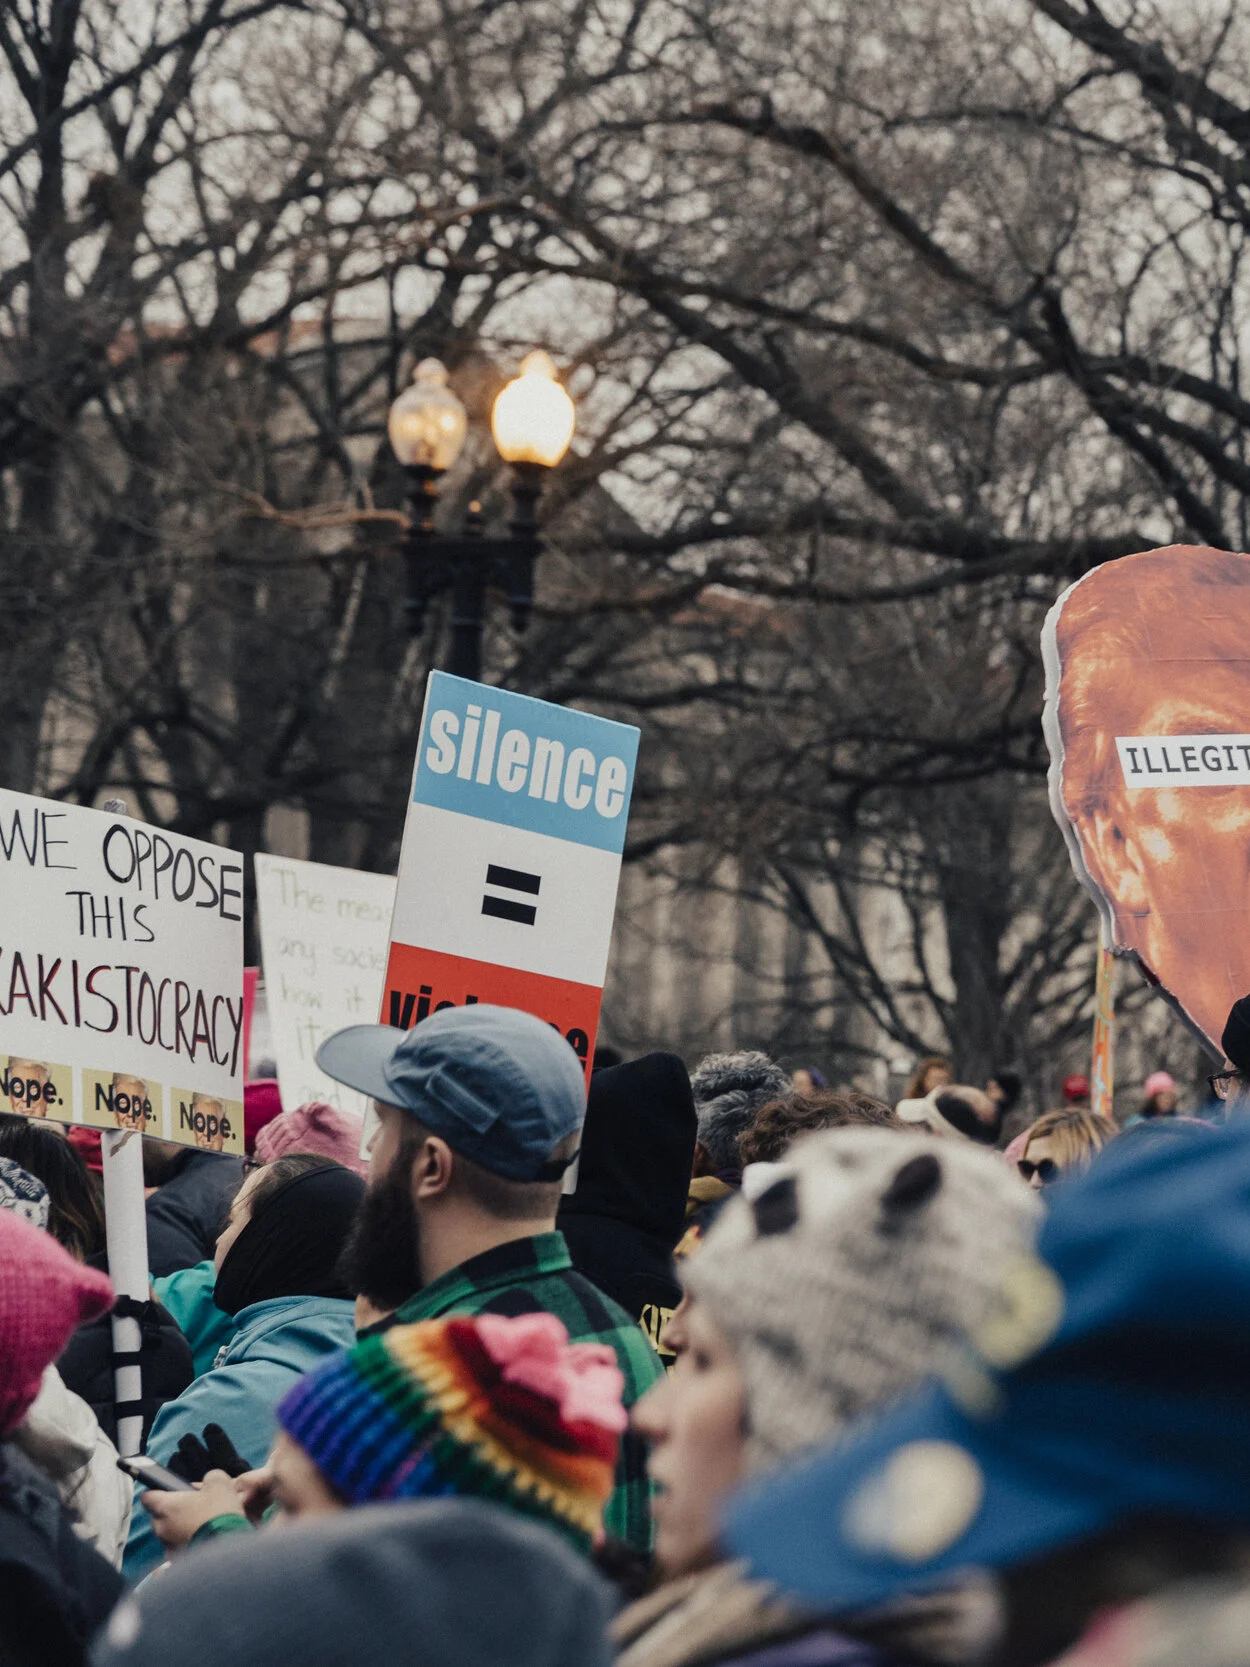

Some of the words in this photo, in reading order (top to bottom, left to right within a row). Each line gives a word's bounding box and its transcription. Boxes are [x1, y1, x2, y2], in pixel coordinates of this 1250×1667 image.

[425, 703, 628, 819] silence
[0, 807, 77, 870] WE
[102, 823, 243, 922] OPPOSE
[65, 890, 155, 942] THIS
[0, 947, 243, 1077] AKISTOCRACY
[95, 1082, 157, 1122] Nope.
[180, 1101, 236, 1142] Nope.
